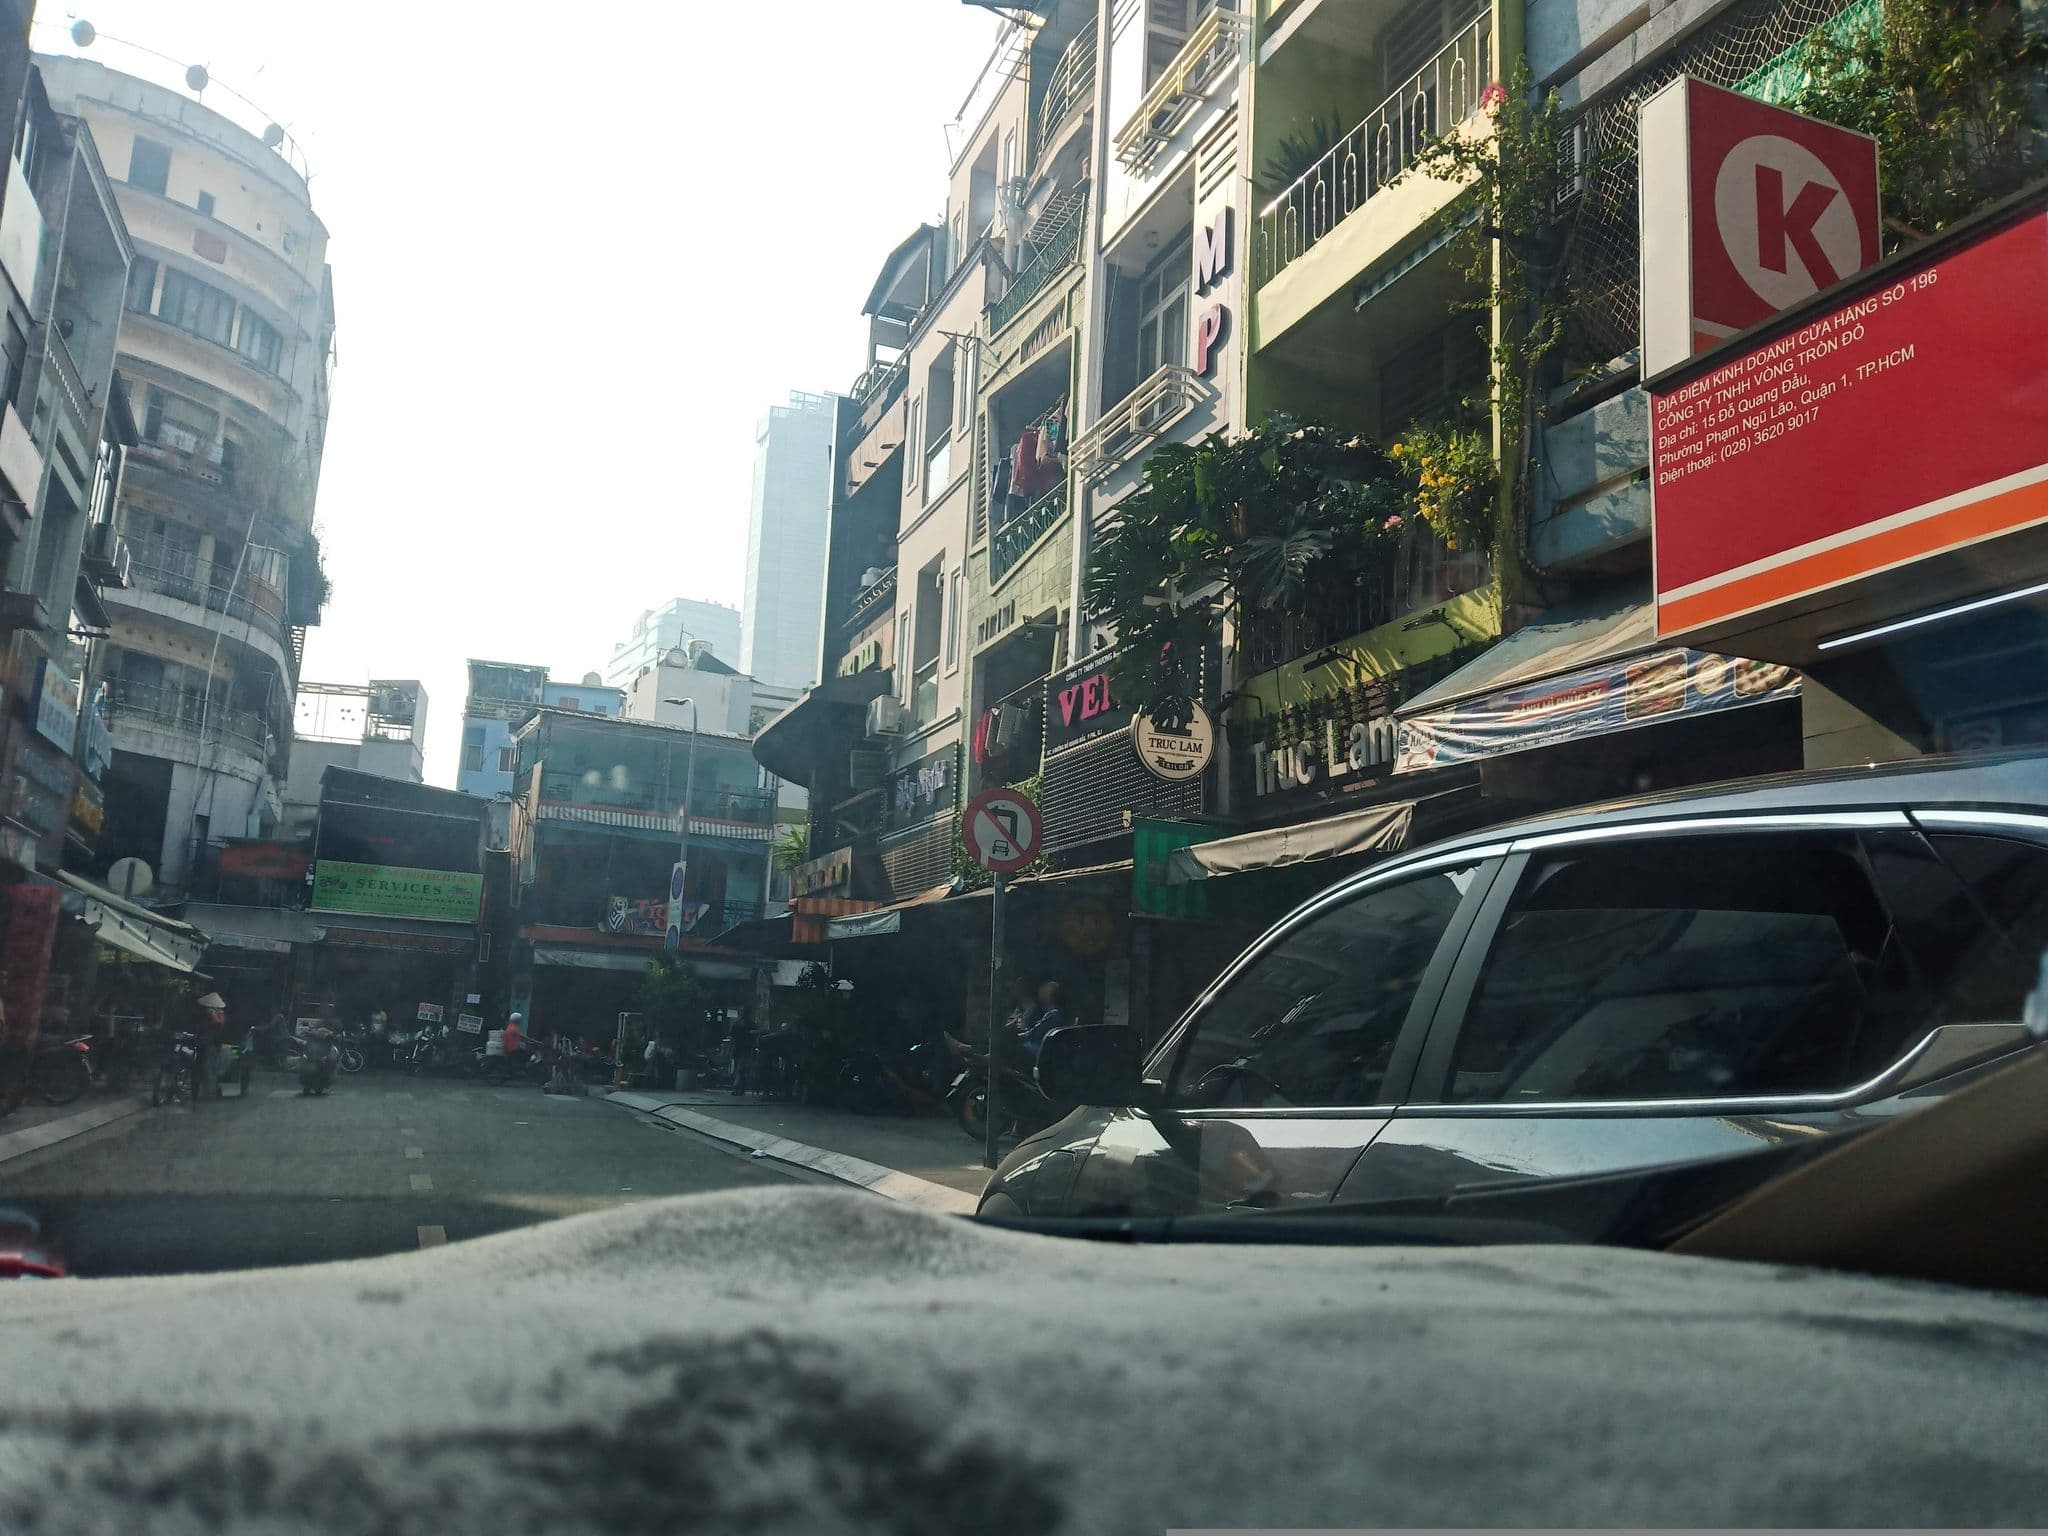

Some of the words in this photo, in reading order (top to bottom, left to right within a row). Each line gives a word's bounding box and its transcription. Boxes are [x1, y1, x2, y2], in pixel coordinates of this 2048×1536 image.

[1755, 163, 1839, 291] K
[1657, 395, 1679, 414] ĐỊA
[1713, 362, 1744, 387] KINH
[1746, 336, 1796, 372] DOANH
[1799, 320, 1832, 346] CỬA
[1834, 298, 1878, 330] HÀNG
[1910, 269, 1938, 293] 196
[1658, 404, 1694, 431] CÔNG
[1696, 395, 1713, 413] TY
[1715, 377, 1751, 405] TNHH
[1754, 358, 1794, 386] VÒNG
[1797, 336, 1838, 367] TRÒN
[1841, 322, 1865, 346] ĐỎ
[1659, 440, 1703, 467] Phường
[1706, 423, 1740, 448] Phạm
[1743, 410, 1767, 432] Ngũ
[1770, 400, 1797, 419] Lão,
[1800, 381, 1837, 405] Quận
[1841, 373, 1853, 388] 1,
[1856, 344, 1915, 380] TP.HCM
[1659, 433, 1677, 450] Địa
[1679, 421, 1699, 442] chỉ:
[1702, 413, 1716, 430] 15
[1718, 402, 1735, 422] Đỗ
[1738, 388, 1778, 413] Quang
[1782, 371, 1811, 395] Đẩu,
[1659, 466, 1684, 486] Điện
[1687, 452, 1718, 474] thoại:
[1720, 436, 1751, 462] (028)
[1754, 422, 1785, 446] 3620
[1788, 406, 1819, 431] 9017
[1148, 737, 1177, 750] TRUC
[1179, 741, 1202, 753] LAM
[1326, 716, 1400, 777] Lam
[357, 879, 442, 895] SERVICES
